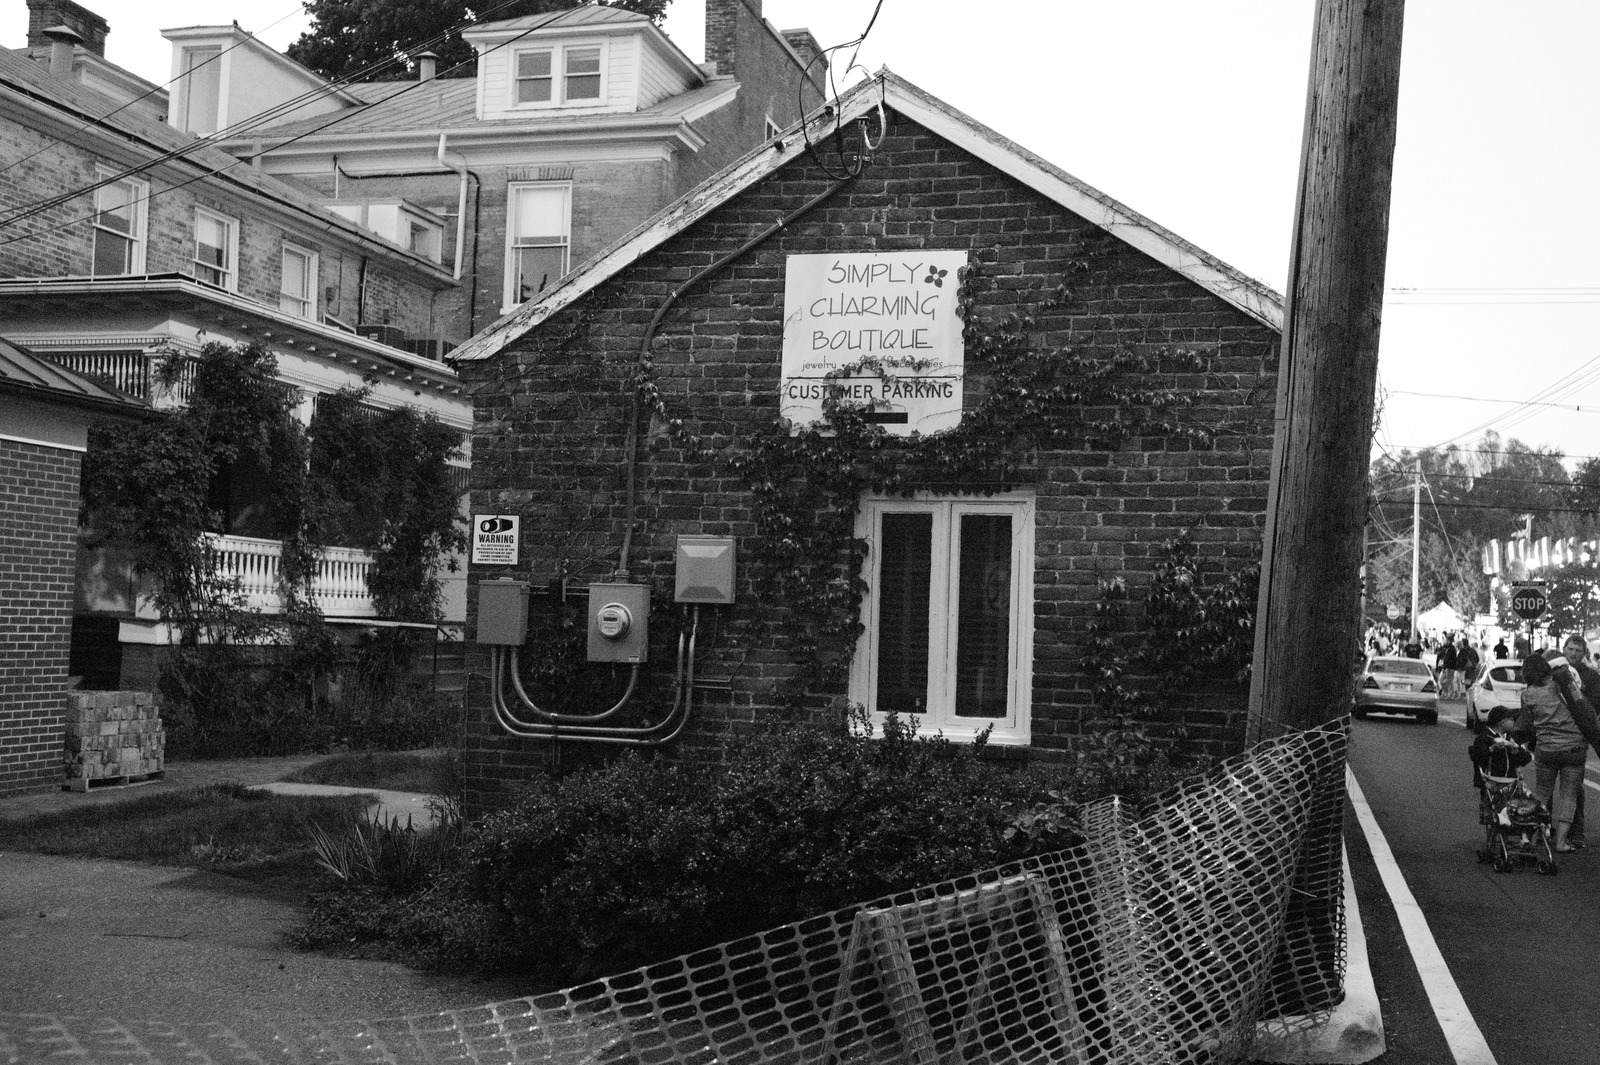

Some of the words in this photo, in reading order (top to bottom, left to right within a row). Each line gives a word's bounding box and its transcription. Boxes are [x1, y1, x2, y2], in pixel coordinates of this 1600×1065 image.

[827, 260, 924, 288] SIMPLY
[810, 290, 939, 320] CHARMING
[812, 328, 933, 352] BOUTIQUE
[801, 355, 837, 372] jewelry
[788, 384, 873, 399] CUSTMER
[882, 384, 953, 399] PARKING
[479, 534, 514, 544] WARNING
[1514, 597, 1544, 610] STOP
